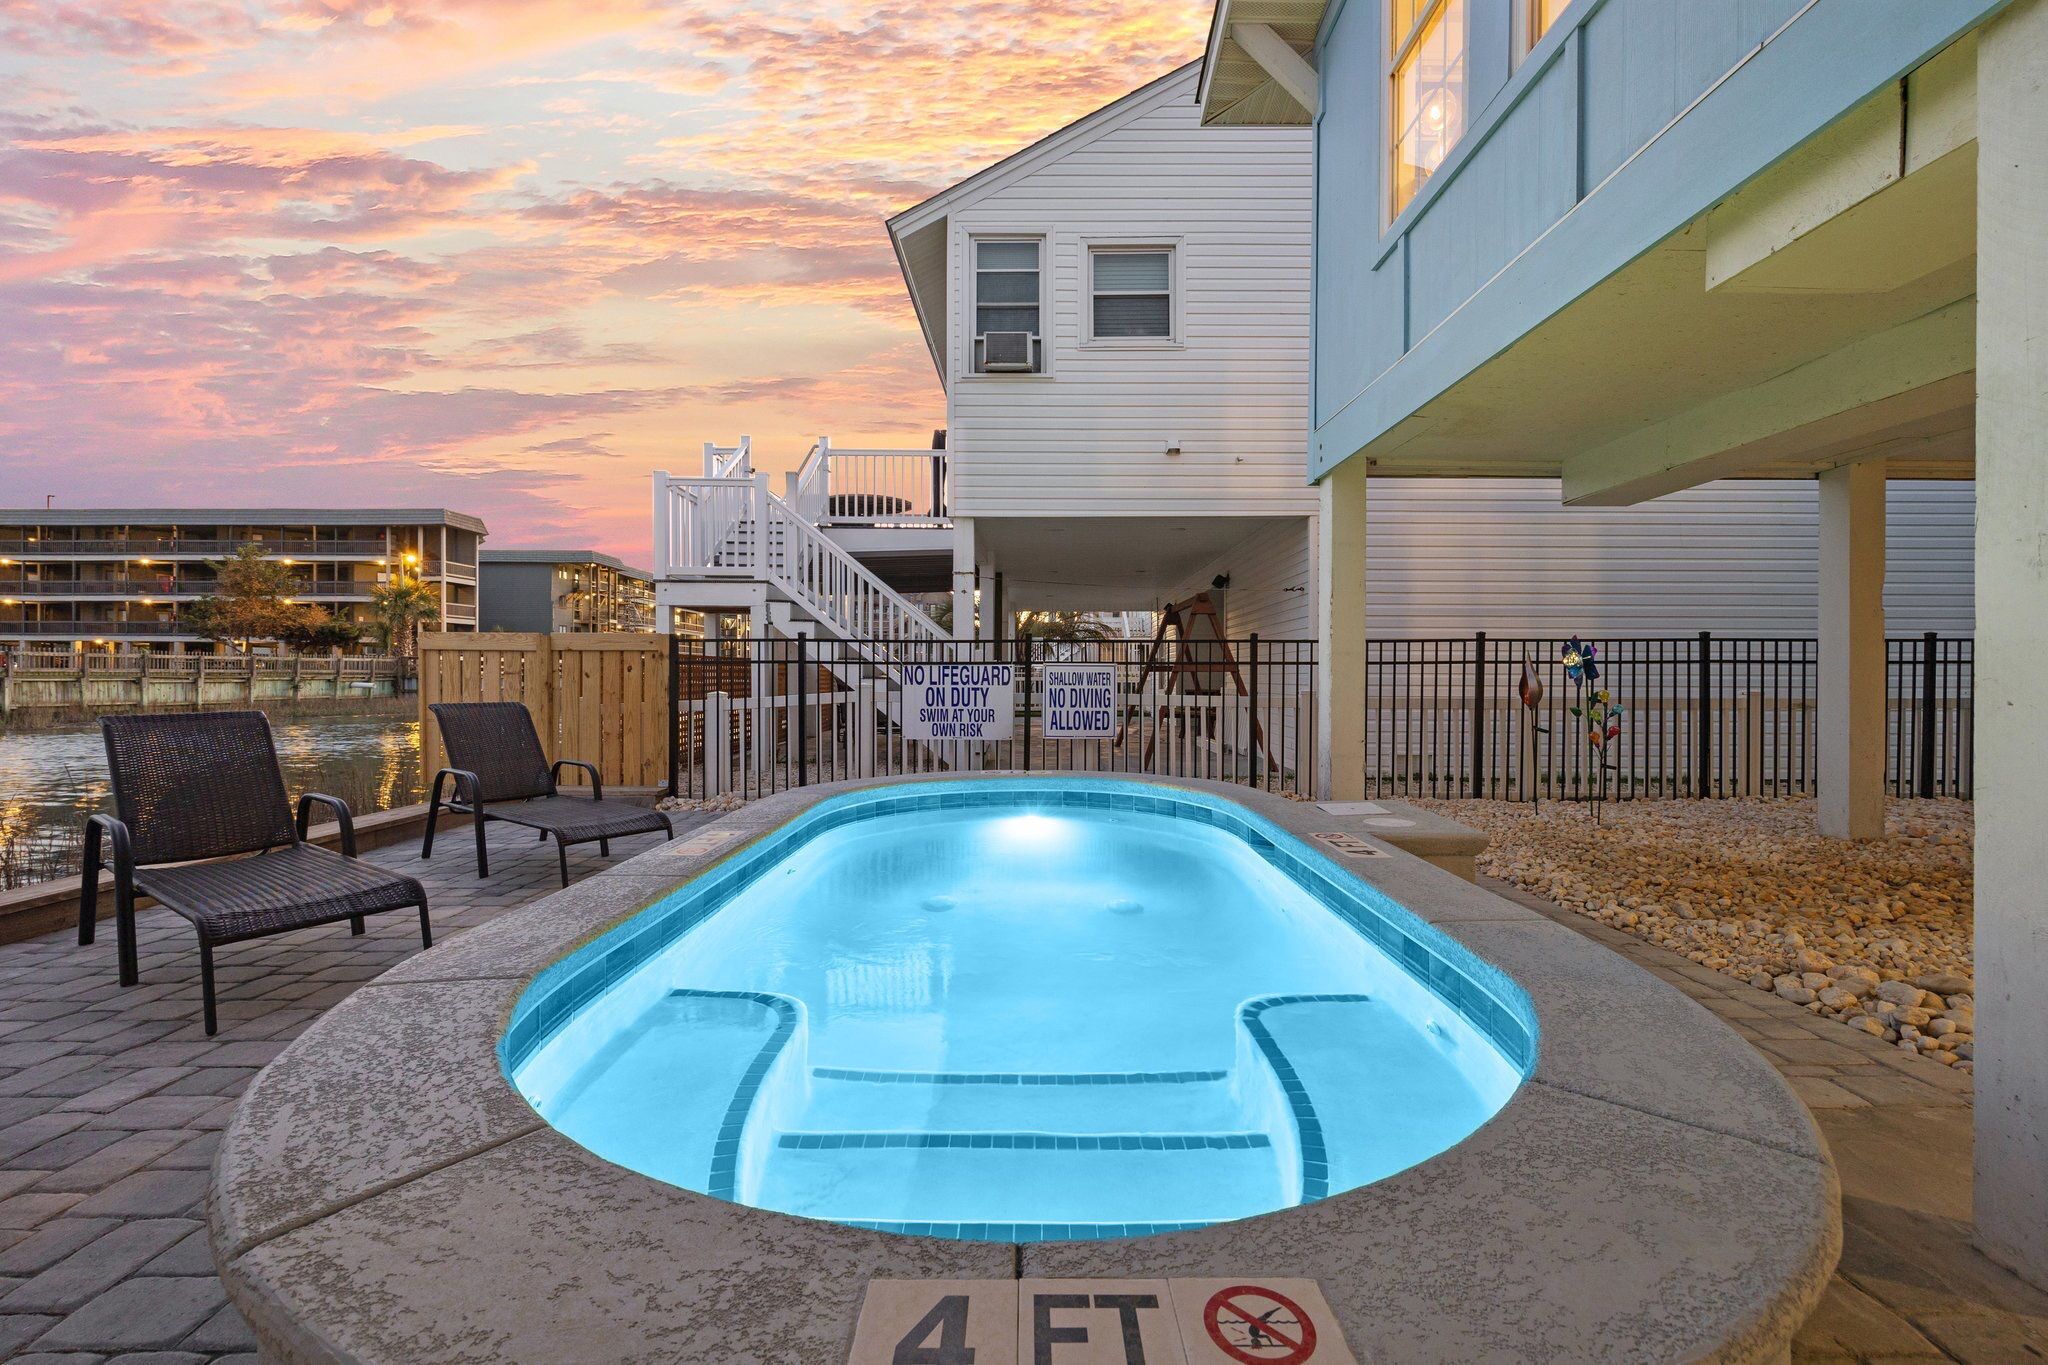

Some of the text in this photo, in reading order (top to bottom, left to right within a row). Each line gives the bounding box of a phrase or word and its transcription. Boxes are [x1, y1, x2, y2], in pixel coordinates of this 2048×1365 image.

[904, 665, 1011, 686] NO LIFEGUARD
[1049, 672, 1111, 686] SHALLOW WATER
[926, 687, 989, 707] ON DUTY
[1049, 688, 1111, 708] NO DIVING
[920, 709, 995, 722] SWIM AT YOUR
[1050, 710, 1110, 730] ALLOWED
[932, 723, 983, 737] OWN RISK
[892, 1294, 1160, 1365] 4 FT
